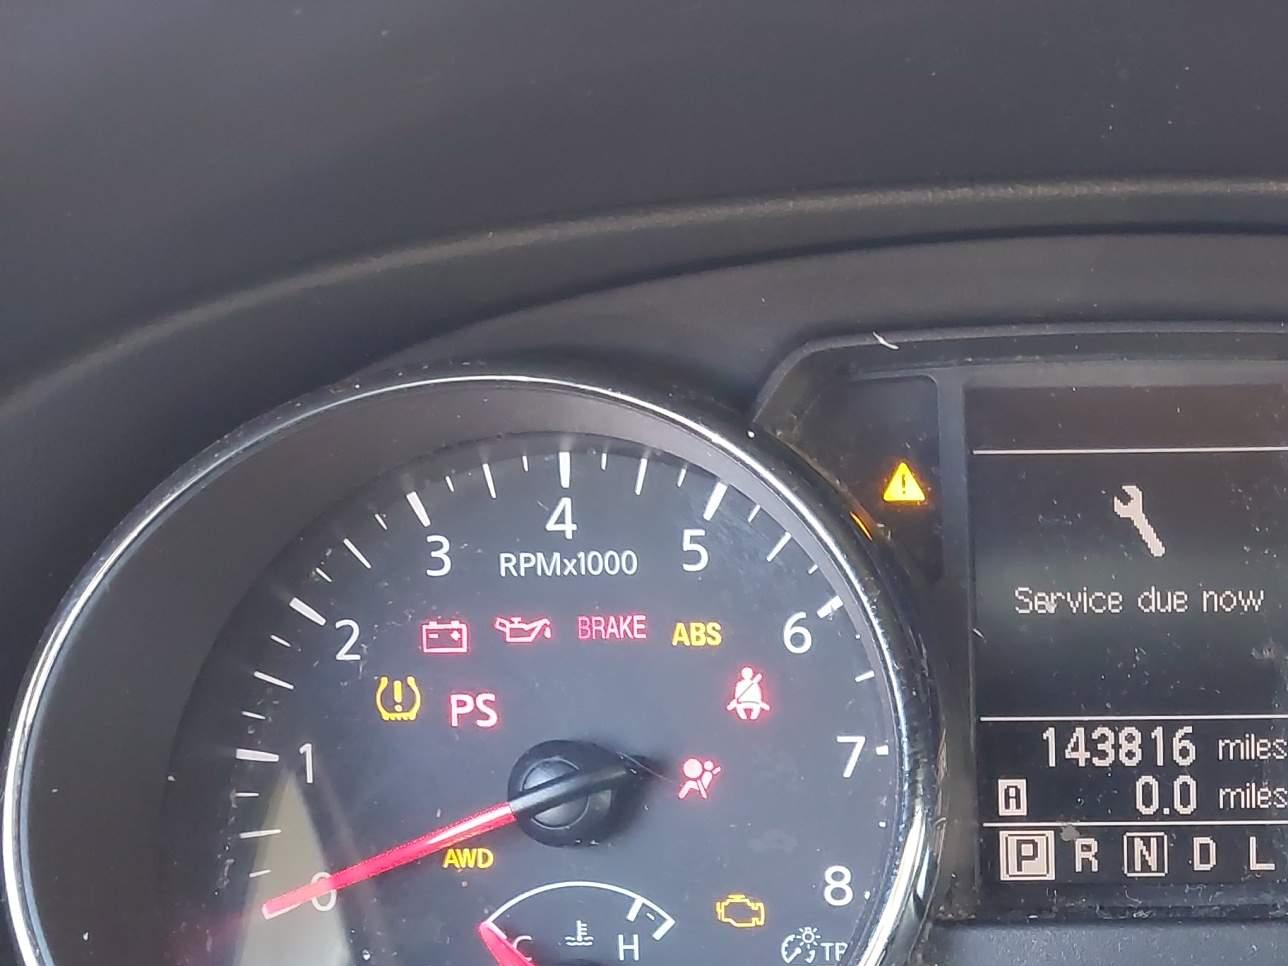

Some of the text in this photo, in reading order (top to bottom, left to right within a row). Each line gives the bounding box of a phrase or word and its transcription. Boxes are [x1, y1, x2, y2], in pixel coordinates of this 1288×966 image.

[545, 497, 578, 540] 4
[426, 534, 452, 577] 3
[499, 549, 638, 577] RPMx1000
[682, 528, 709, 572] 5
[1014, 585, 1264, 614] Service due now
[335, 619, 361, 661] 2
[578, 614, 647, 640] BRAKE
[671, 622, 722, 647] ABS
[783, 611, 812, 654] 6
[450, 693, 498, 728] PS
[299, 743, 313, 784] 1
[836, 735, 866, 778] 7
[1042, 726, 1288, 767] 143816 miles
[1135, 775, 1288, 815] 0.0 miles
[443, 847, 494, 869] AWD
[1074, 837, 1099, 873] R
[1134, 837, 1158, 873] N
[1193, 836, 1217, 871] D
[1249, 836, 1276, 871] L
[823, 865, 854, 906] 8
[617, 933, 640, 961] H
